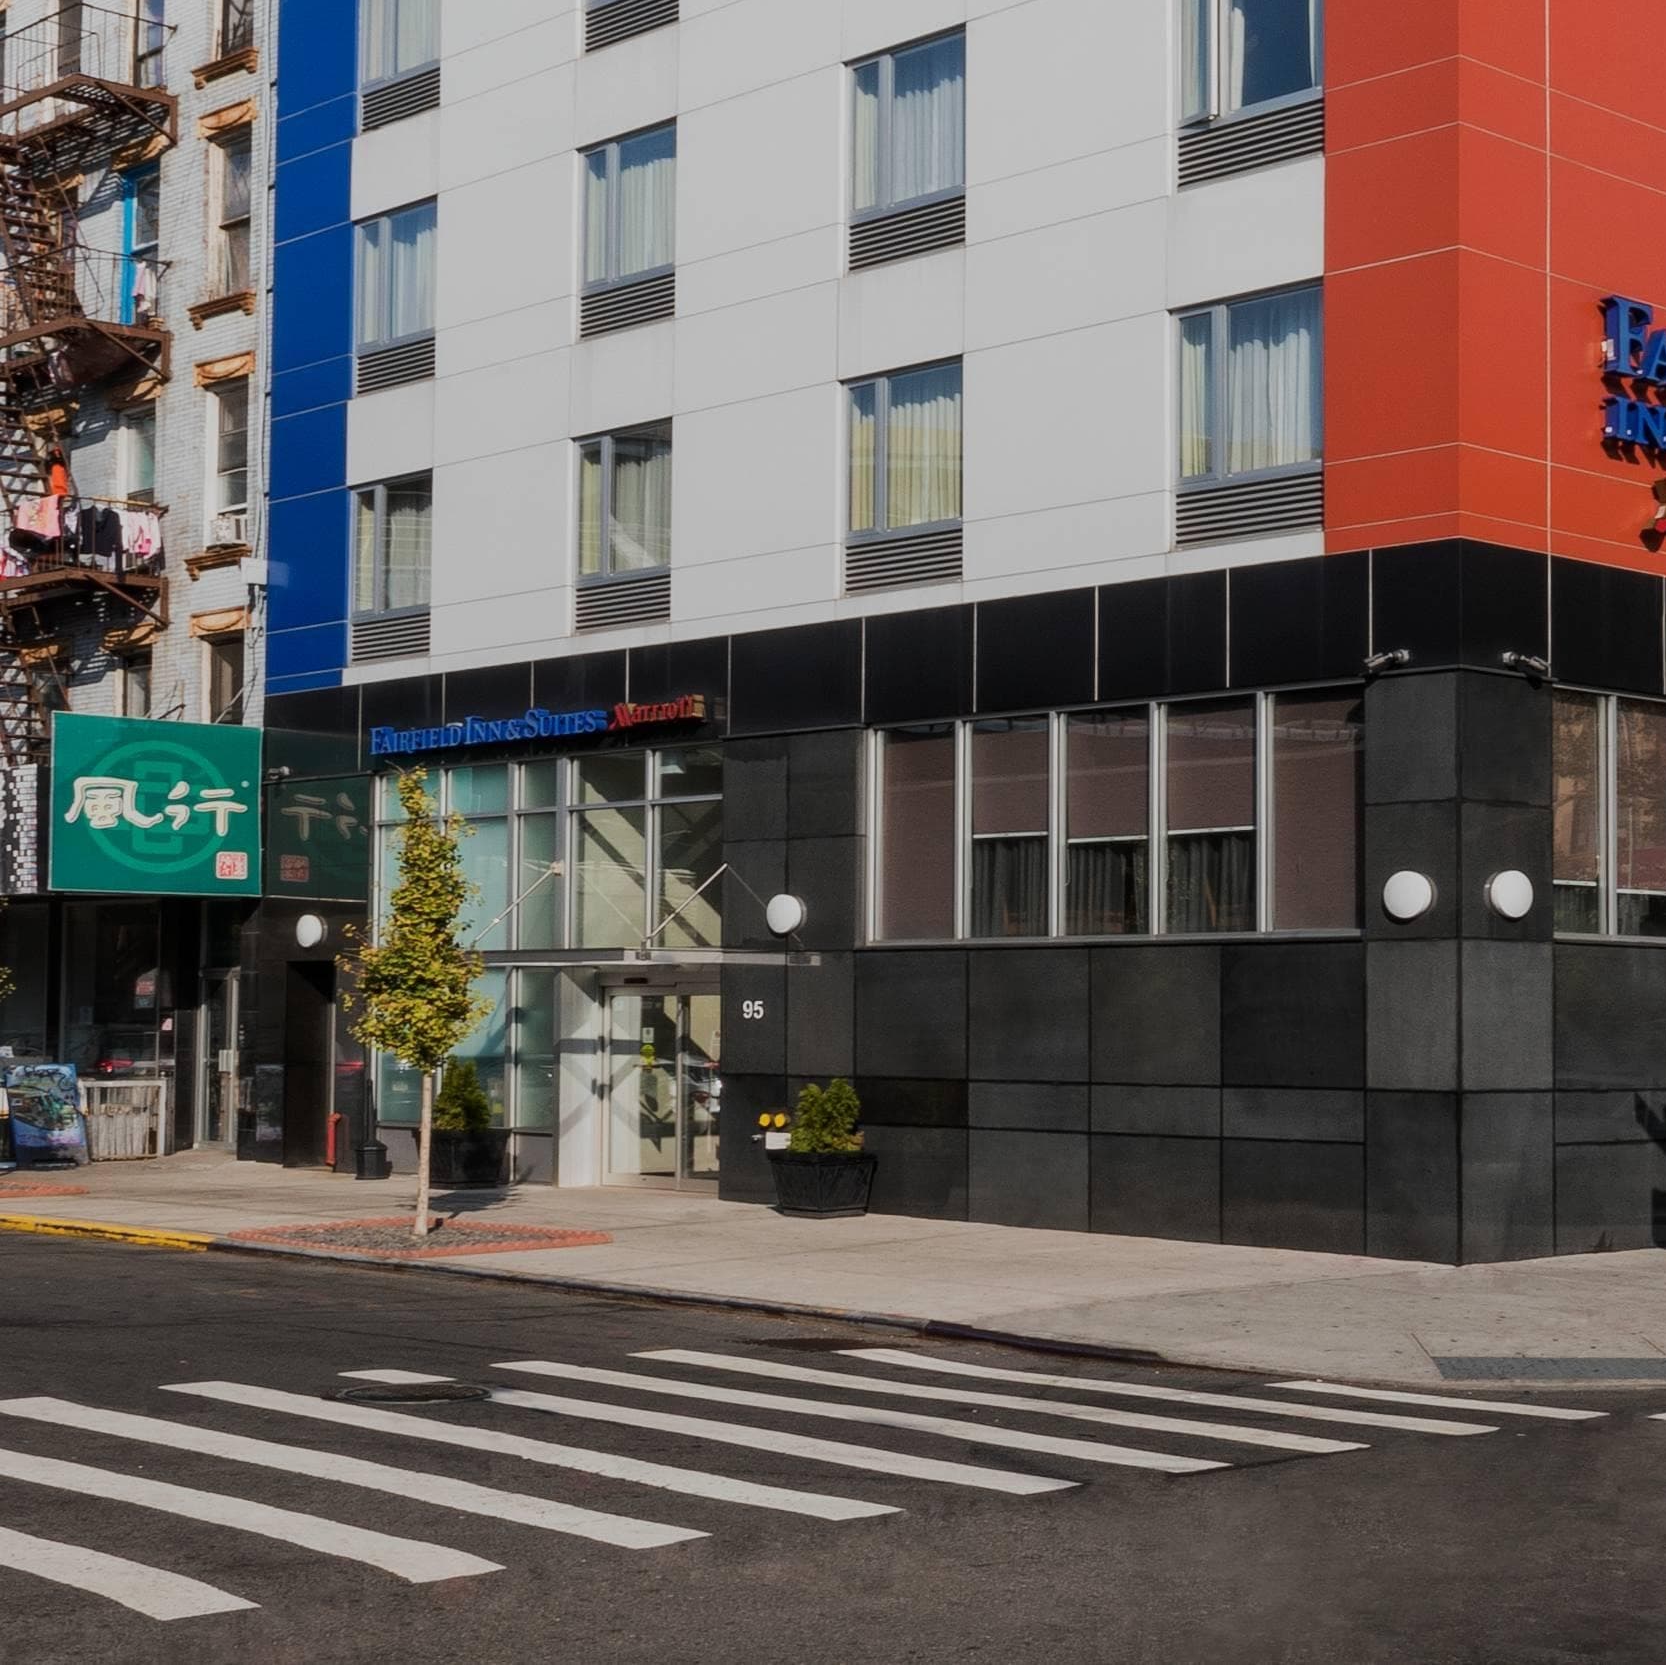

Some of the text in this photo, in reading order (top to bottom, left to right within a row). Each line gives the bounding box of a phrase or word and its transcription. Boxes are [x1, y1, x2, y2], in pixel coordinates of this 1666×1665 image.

[370, 725, 462, 755] FAIRFIELD
[464, 715, 502, 745] INN
[523, 708, 606, 739] SUITES
[609, 695, 700, 730] Marriott
[64, 776, 248, 837] 風行
[742, 1000, 765, 1020] 95
